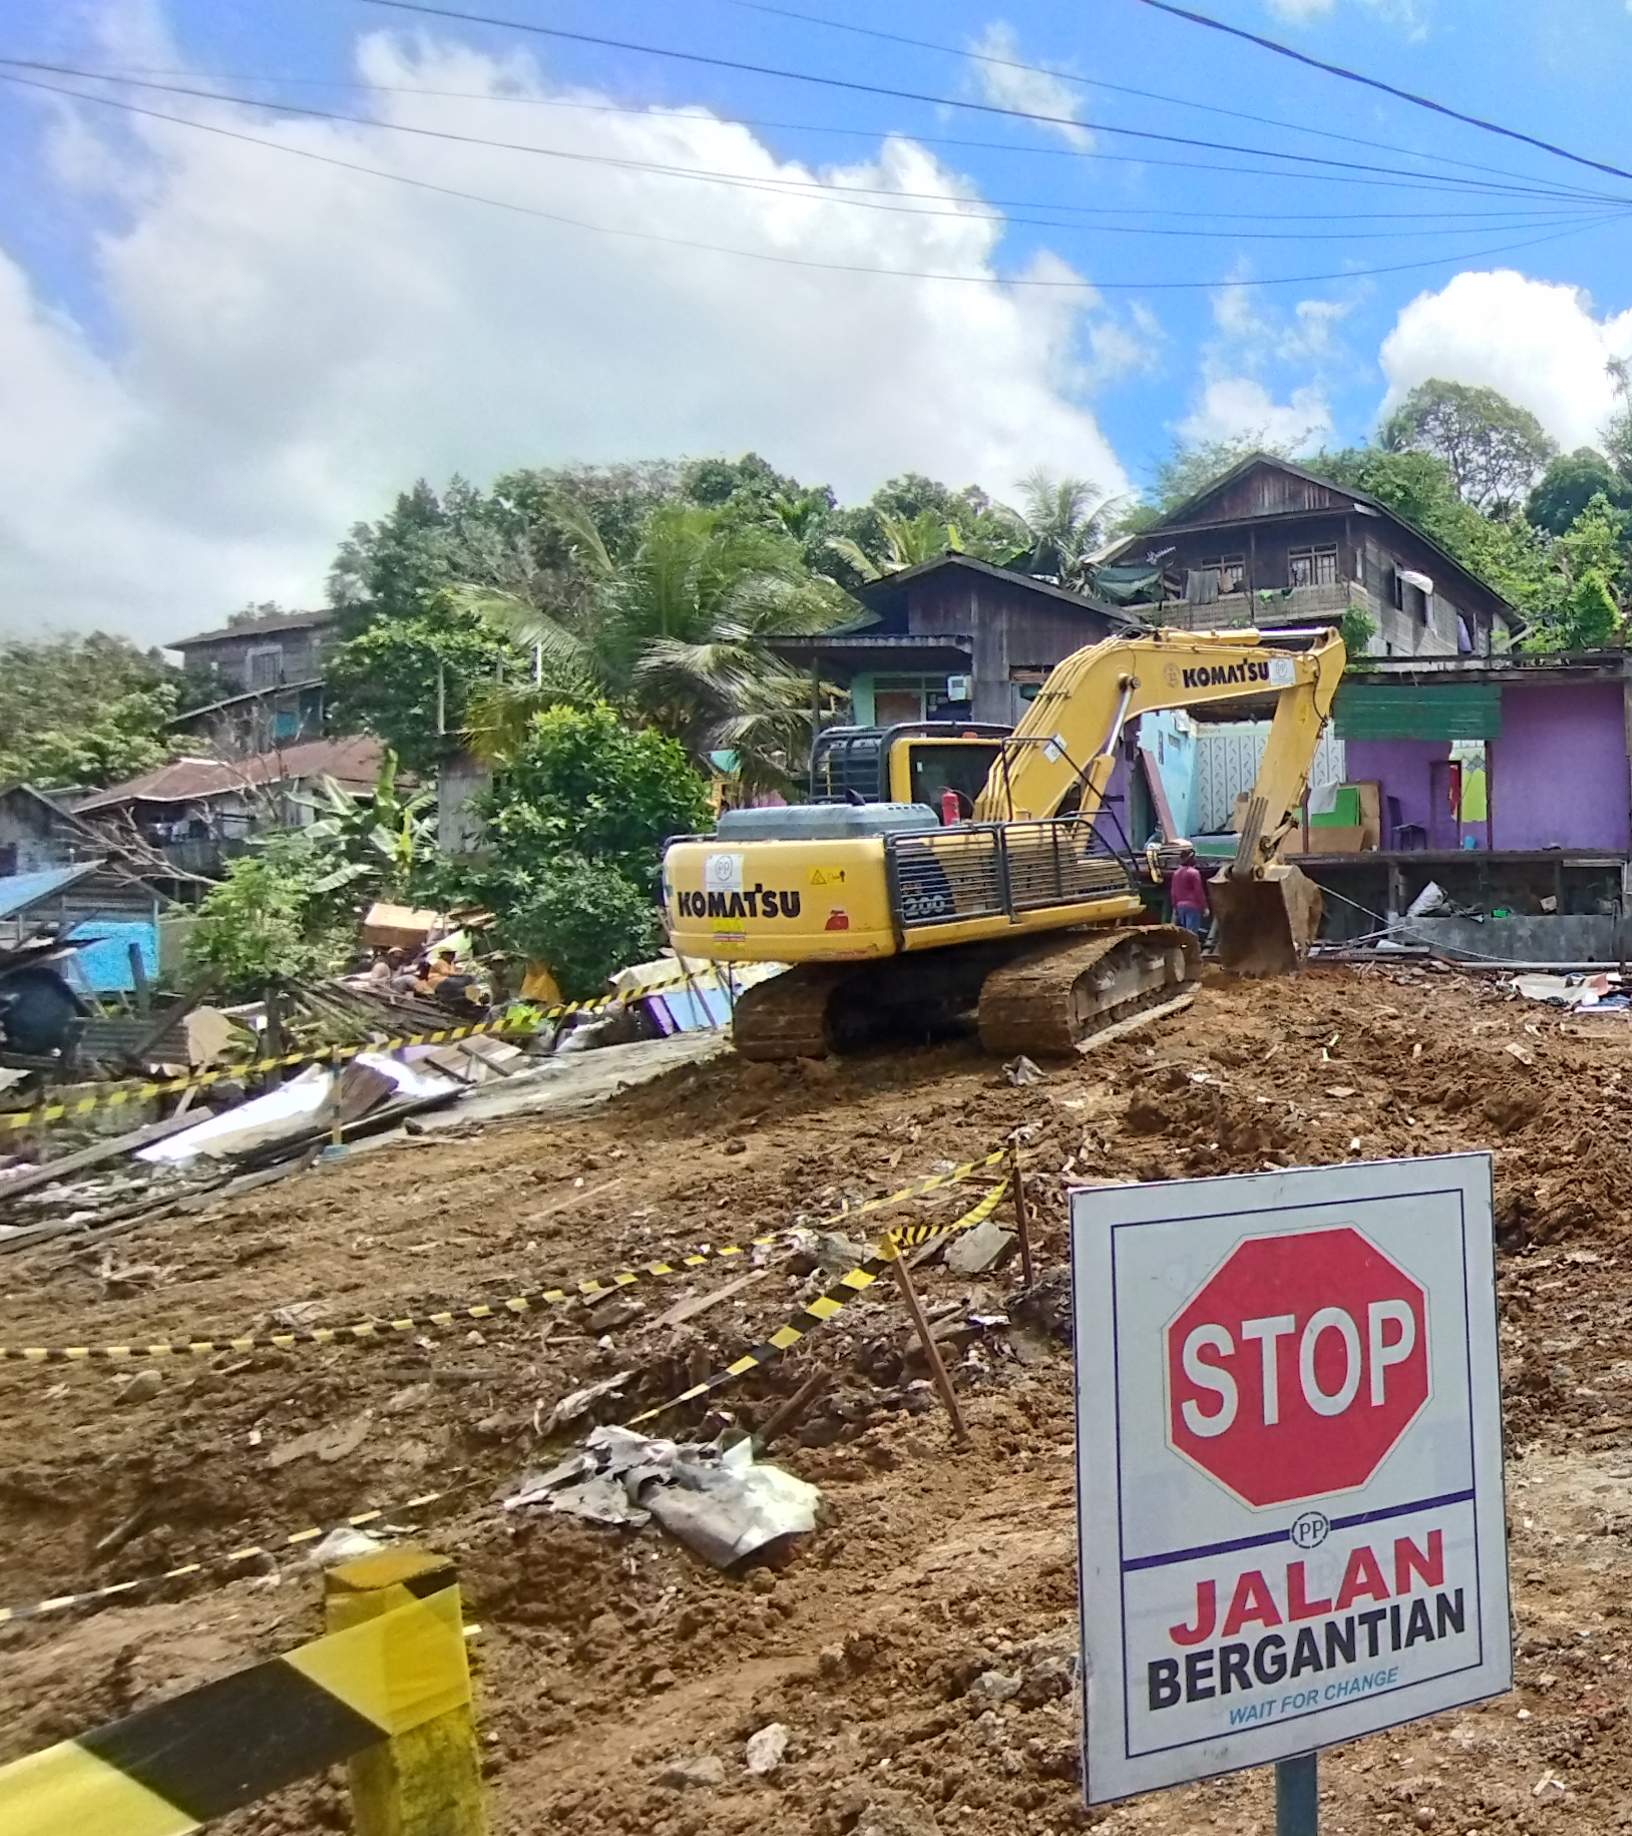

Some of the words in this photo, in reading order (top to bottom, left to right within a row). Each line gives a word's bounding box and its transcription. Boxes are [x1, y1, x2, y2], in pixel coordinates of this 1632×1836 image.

[1182, 658, 1270, 688] KOMATSU
[677, 884, 800, 918] KOMATSU
[1181, 1299, 1416, 1438] STOP
[1299, 1520, 1325, 1542] PP
[1168, 1529, 1445, 1646] JALAN
[1148, 1588, 1465, 1711] BERGANTIAN
[1229, 1700, 1277, 1725] WAIT
[1280, 1689, 1319, 1713] FOR
[1324, 1666, 1400, 1701] CHANGE
